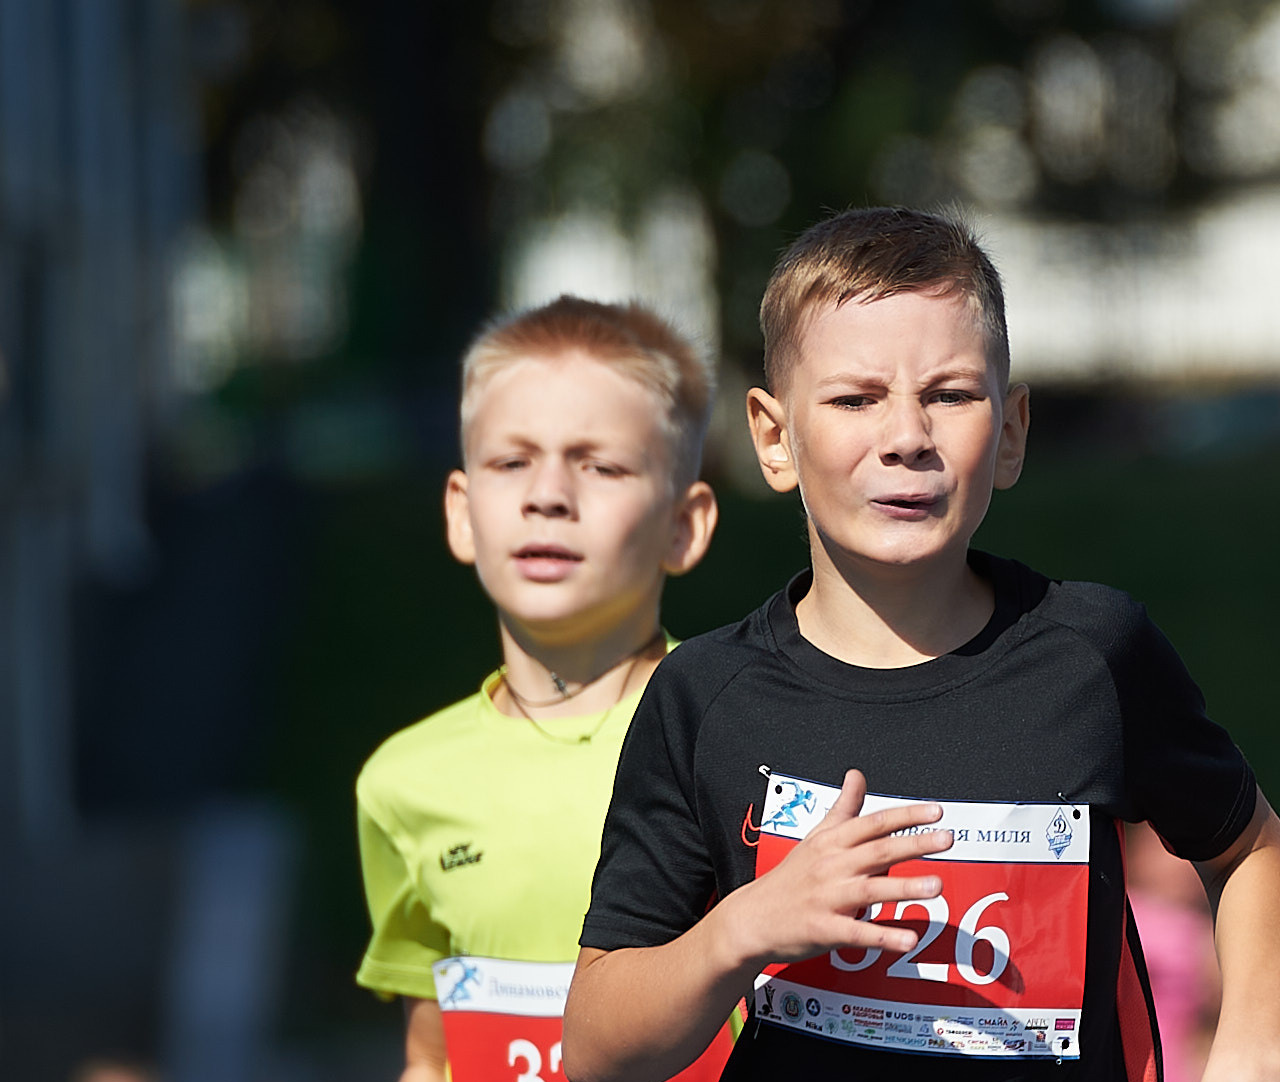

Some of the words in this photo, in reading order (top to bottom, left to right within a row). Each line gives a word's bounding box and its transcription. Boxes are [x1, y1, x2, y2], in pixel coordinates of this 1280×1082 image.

[977, 830, 1031, 844] миля
[894, 1012, 914, 1021] UDS
[978, 1017, 1008, 1026] СМАЙЛ
